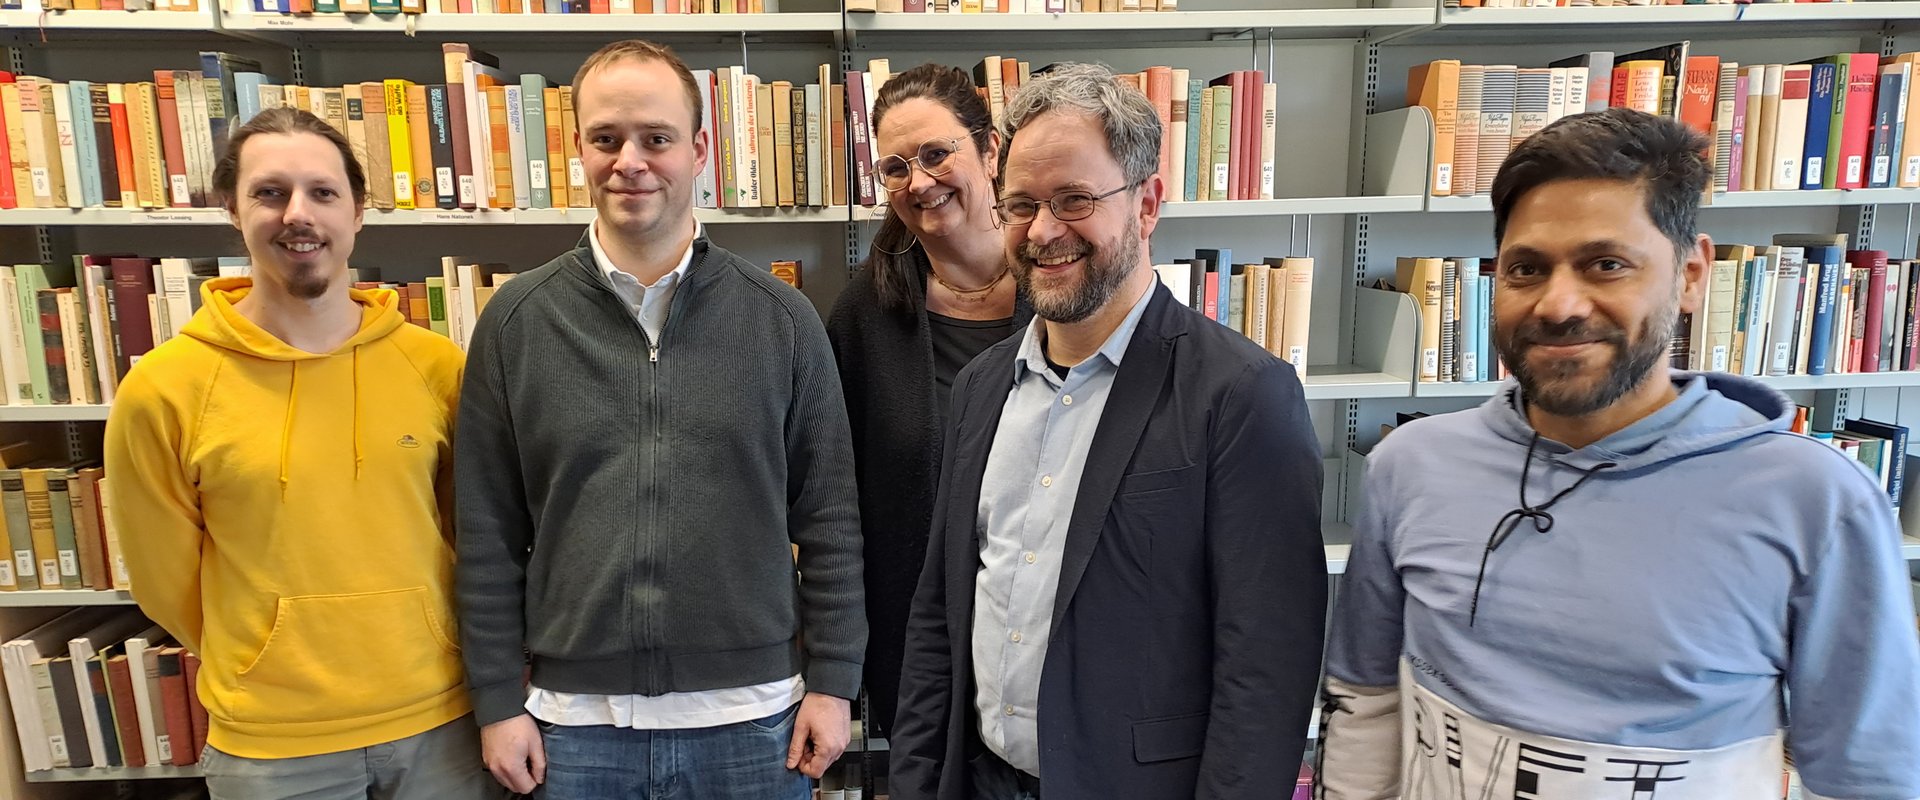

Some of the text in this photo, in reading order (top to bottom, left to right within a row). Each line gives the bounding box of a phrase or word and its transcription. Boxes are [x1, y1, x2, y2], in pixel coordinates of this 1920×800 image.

[1686, 84, 1709, 95] Nach
[1698, 92, 1712, 106] ruf
[1819, 264, 1832, 314] Manfred Krug
[1829, 264, 1839, 305] ABGEHAUEN
